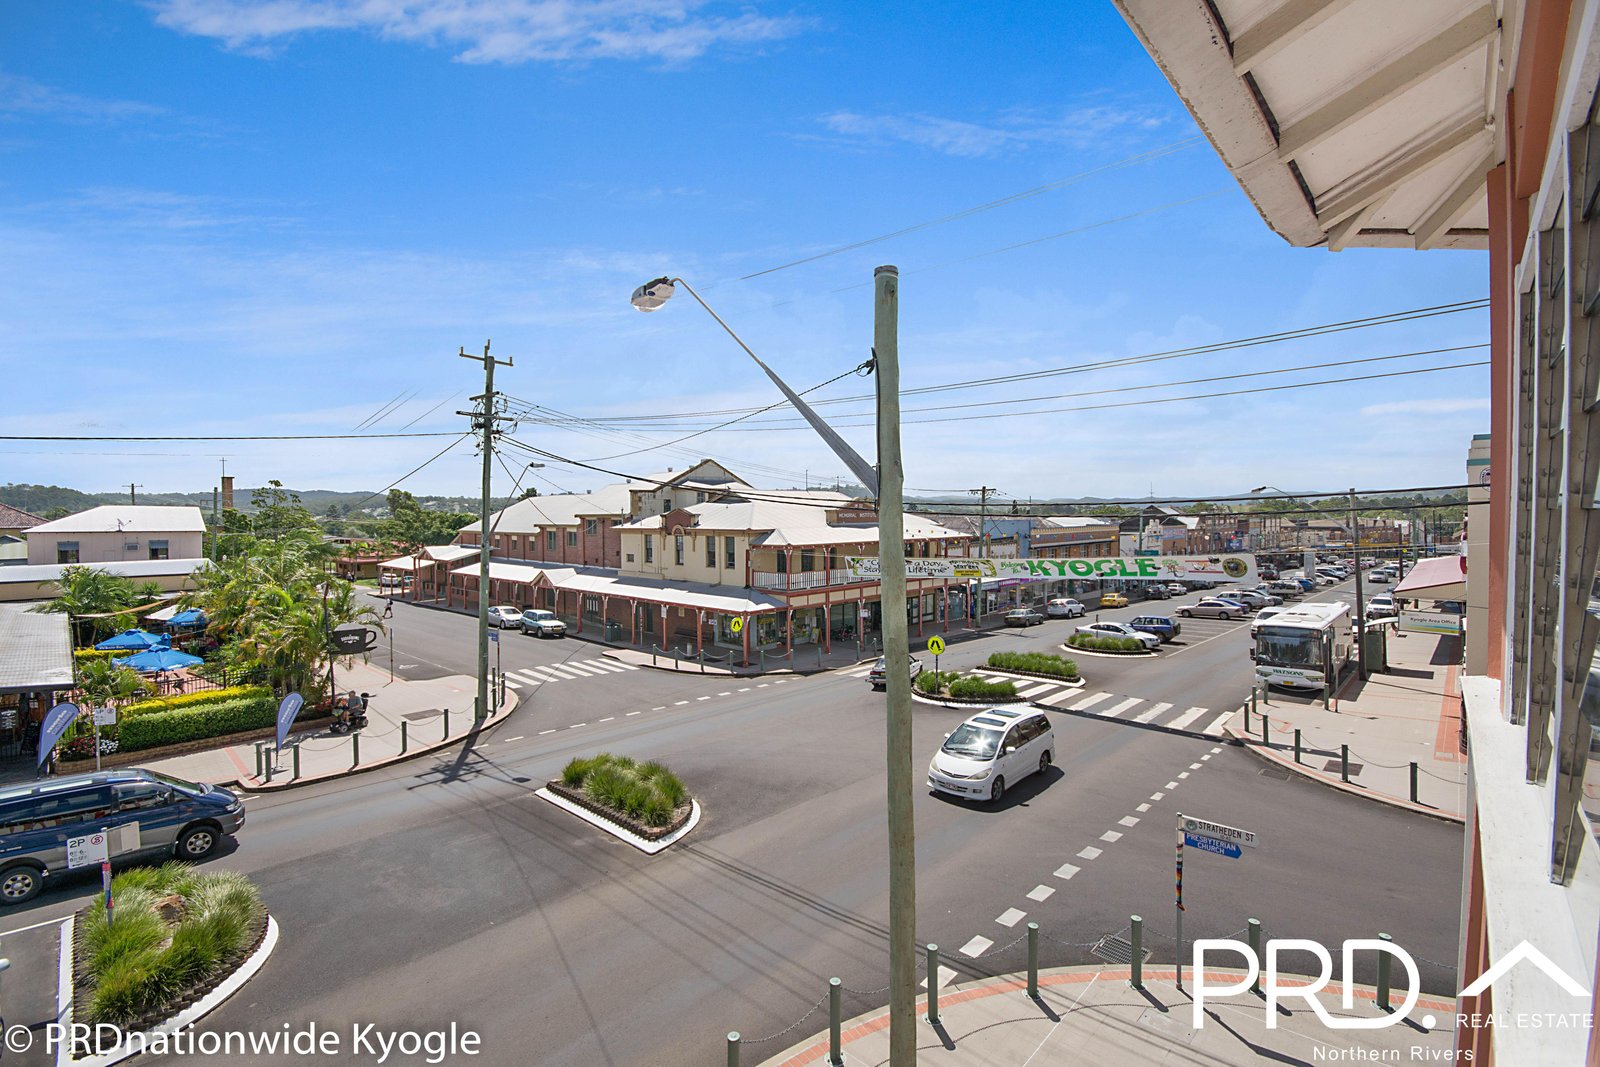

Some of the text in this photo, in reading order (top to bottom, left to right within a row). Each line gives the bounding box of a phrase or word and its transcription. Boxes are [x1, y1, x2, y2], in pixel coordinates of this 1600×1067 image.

[1026, 557, 1159, 577] KYOGLE
[1272, 668, 1304, 676] WATSONS
[1198, 821, 1256, 843] STRATHEDEN ST
[69, 838, 86, 849] 2P
[1186, 832, 1237, 852] PRESBYTERIAN
[1197, 841, 1225, 855] CHURCH
